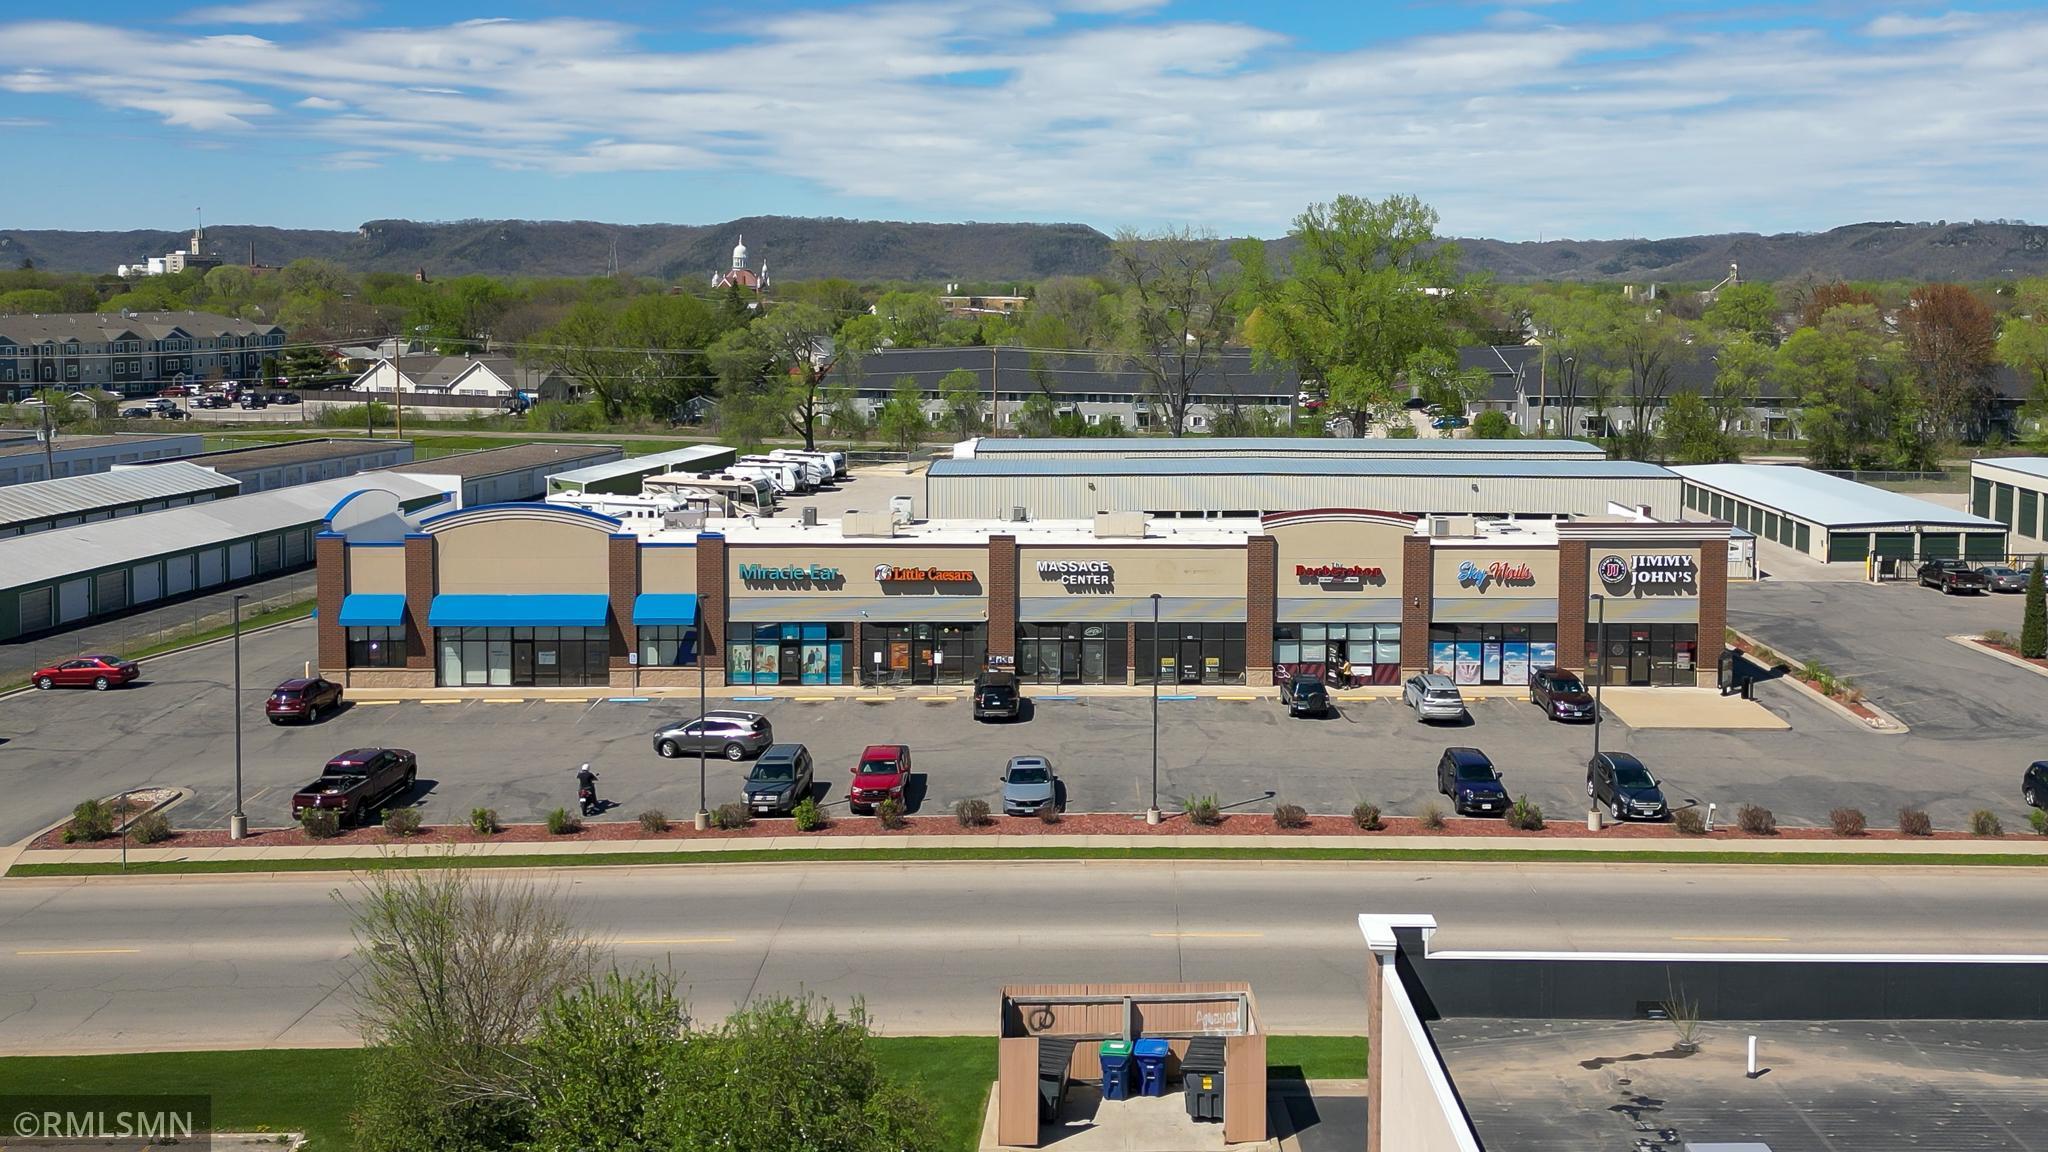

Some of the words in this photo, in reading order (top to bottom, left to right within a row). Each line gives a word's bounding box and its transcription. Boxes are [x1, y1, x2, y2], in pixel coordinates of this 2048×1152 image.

[1036, 560, 1109, 572] MASSAGE
[1631, 555, 1692, 569] JIMMY
[893, 566, 925, 581] Little
[927, 567, 974, 582] Caesars
[1295, 565, 1382, 577] Barbershop
[1457, 560, 1488, 587] Sky
[1490, 561, 1533, 580] Nails
[1061, 575, 1109, 585] CENTER
[1630, 571, 1692, 586] JOHN'S
